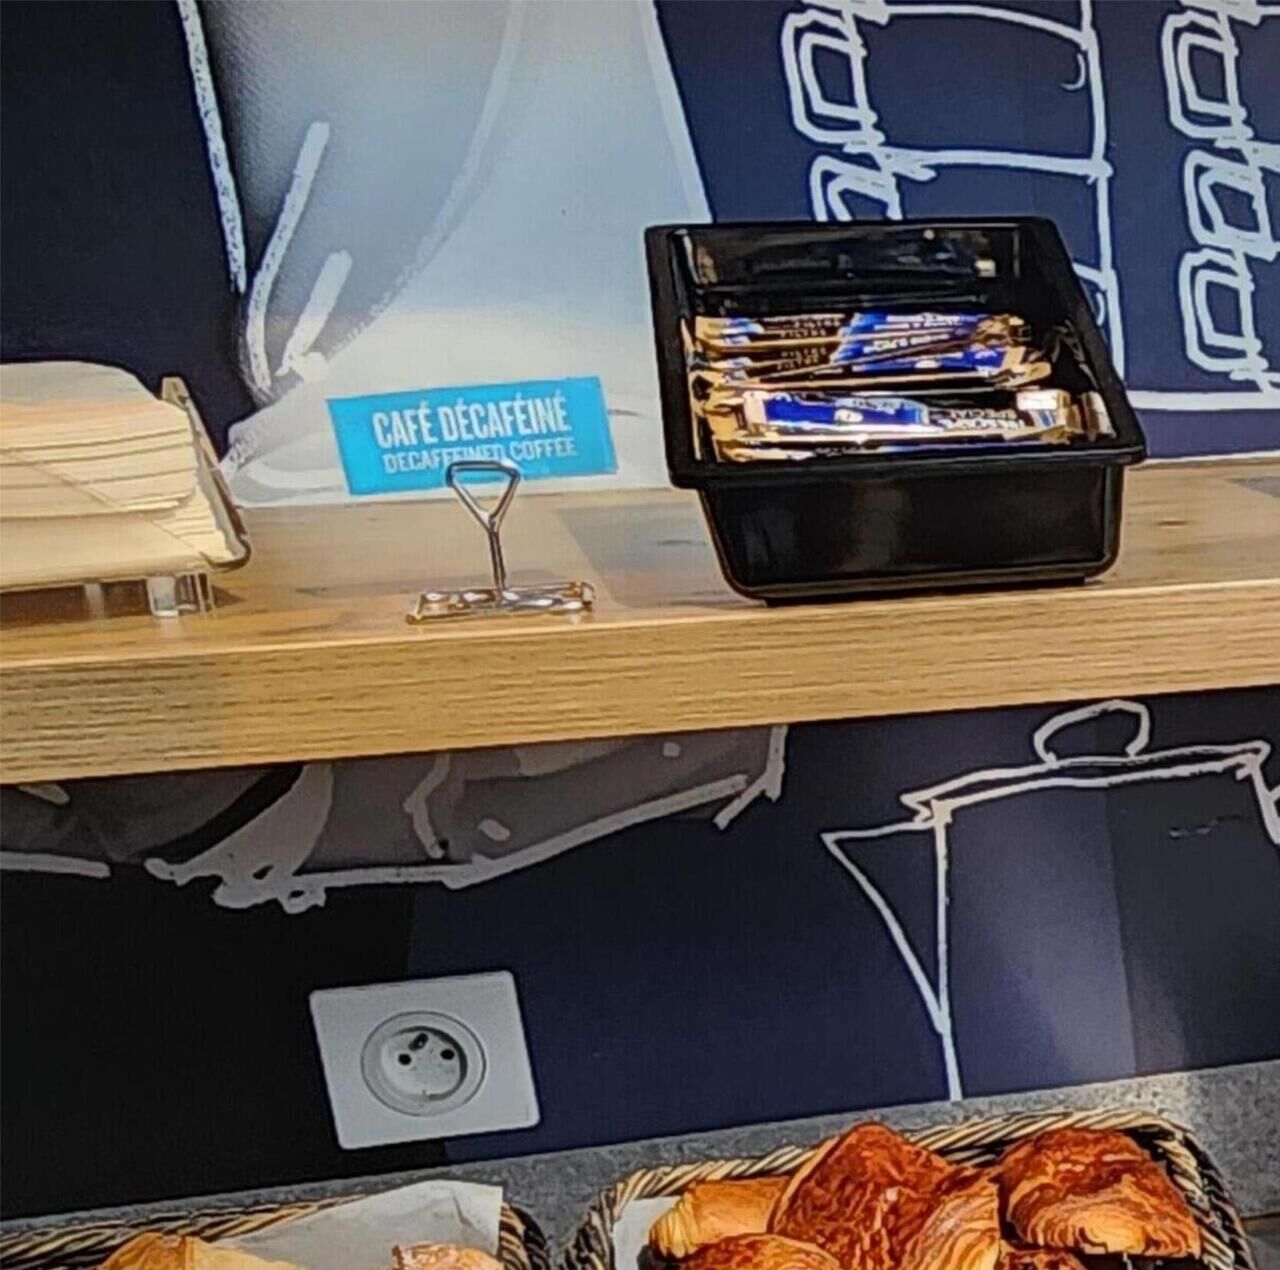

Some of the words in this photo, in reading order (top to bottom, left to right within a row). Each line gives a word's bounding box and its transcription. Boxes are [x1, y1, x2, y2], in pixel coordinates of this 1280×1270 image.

[372, 401, 438, 449] CAFÉ
[436, 390, 572, 442] DÉCAFÉINÉ
[510, 437, 577, 461] COFFEE
